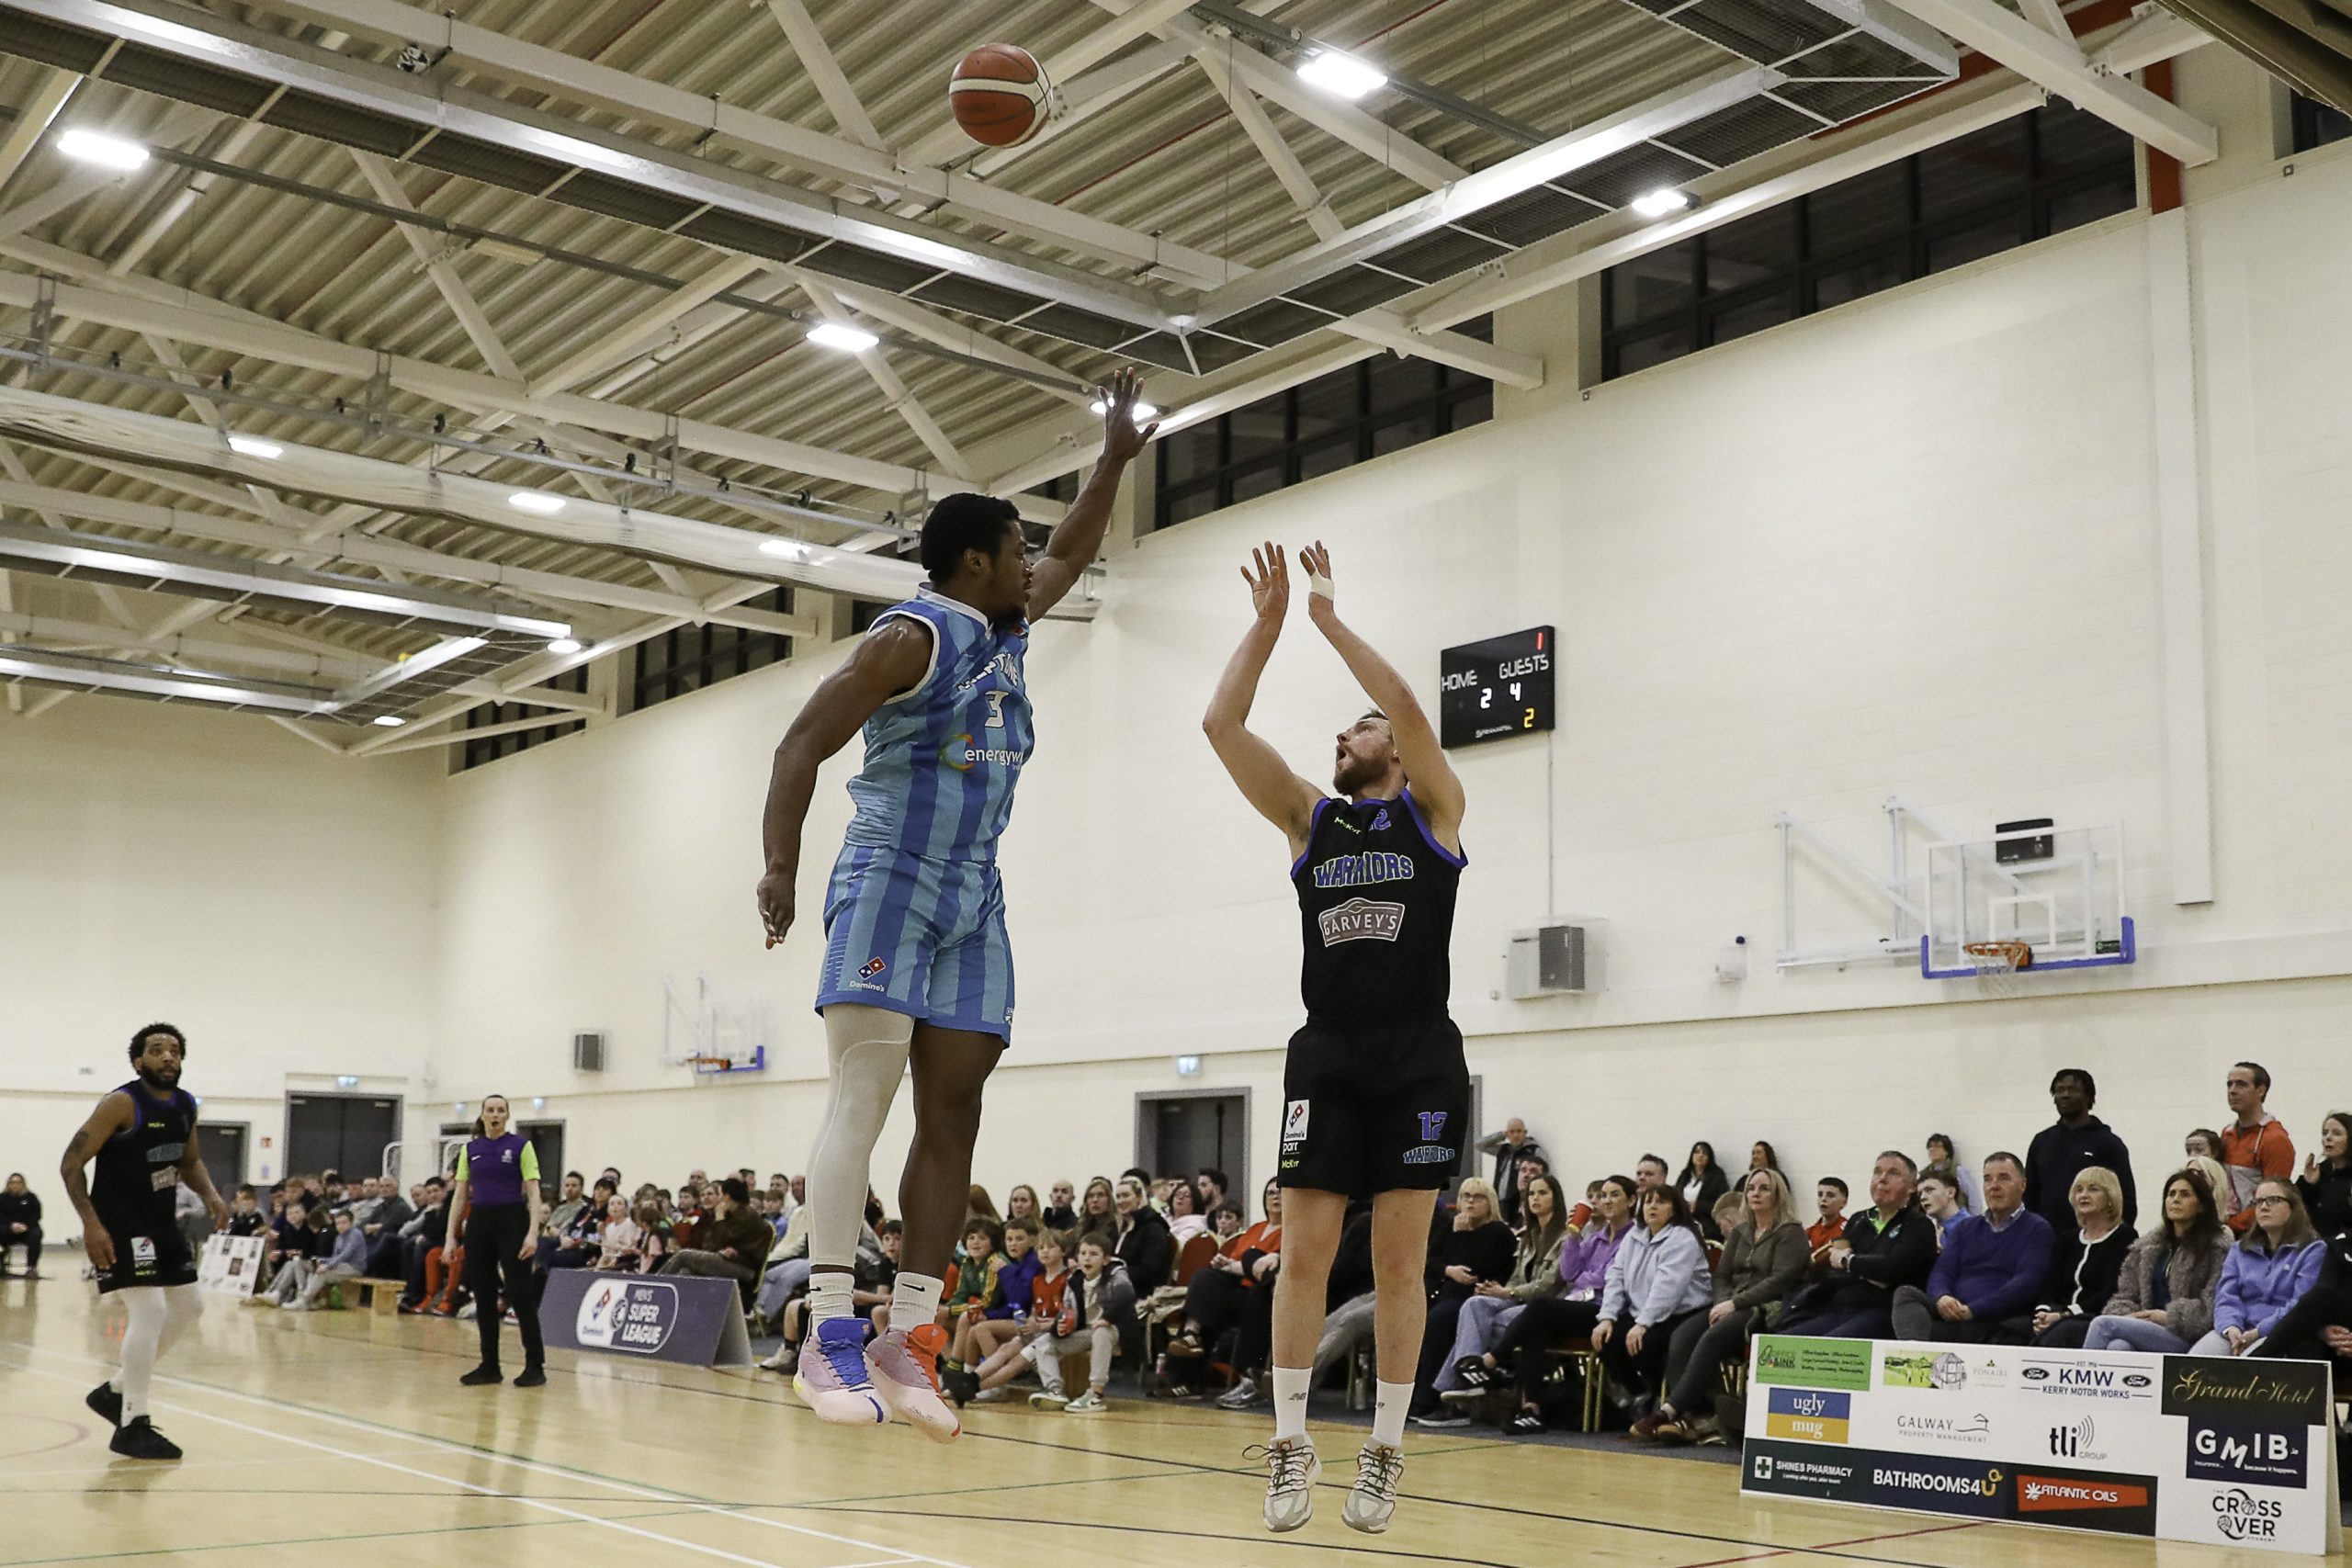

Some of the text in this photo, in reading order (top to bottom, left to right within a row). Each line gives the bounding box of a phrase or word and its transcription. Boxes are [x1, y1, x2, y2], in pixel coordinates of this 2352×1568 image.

[1441, 654, 1549, 692] HOME GUESTS
[1480, 682, 1521, 709] 2 4
[985, 690, 1010, 728] 3
[1523, 707, 1535, 728] 2
[1324, 913, 1397, 936] GARVEY'S
[849, 980, 885, 992] Domino's
[1418, 1111, 1448, 1141] 12
[628, 1303, 660, 1324] SUPER
[622, 1324, 662, 1345] LEAGUE
[2059, 1369, 2114, 1386] KMW
[2172, 1367, 2315, 1404] Grand Hotel
[2042, 1385, 2130, 1399] KERRY MOTOR WORKS
[1792, 1393, 1826, 1416] ugly
[1792, 1420, 1824, 1439] mug
[1897, 1416, 1954, 1431] GALWAY
[2050, 1426, 2077, 1458] tli
[2079, 1451, 2108, 1461] GROUP
[1806, 1463, 1853, 1478] PHARMACY
[2041, 1484, 2119, 1503] ATLANTIC OILS
